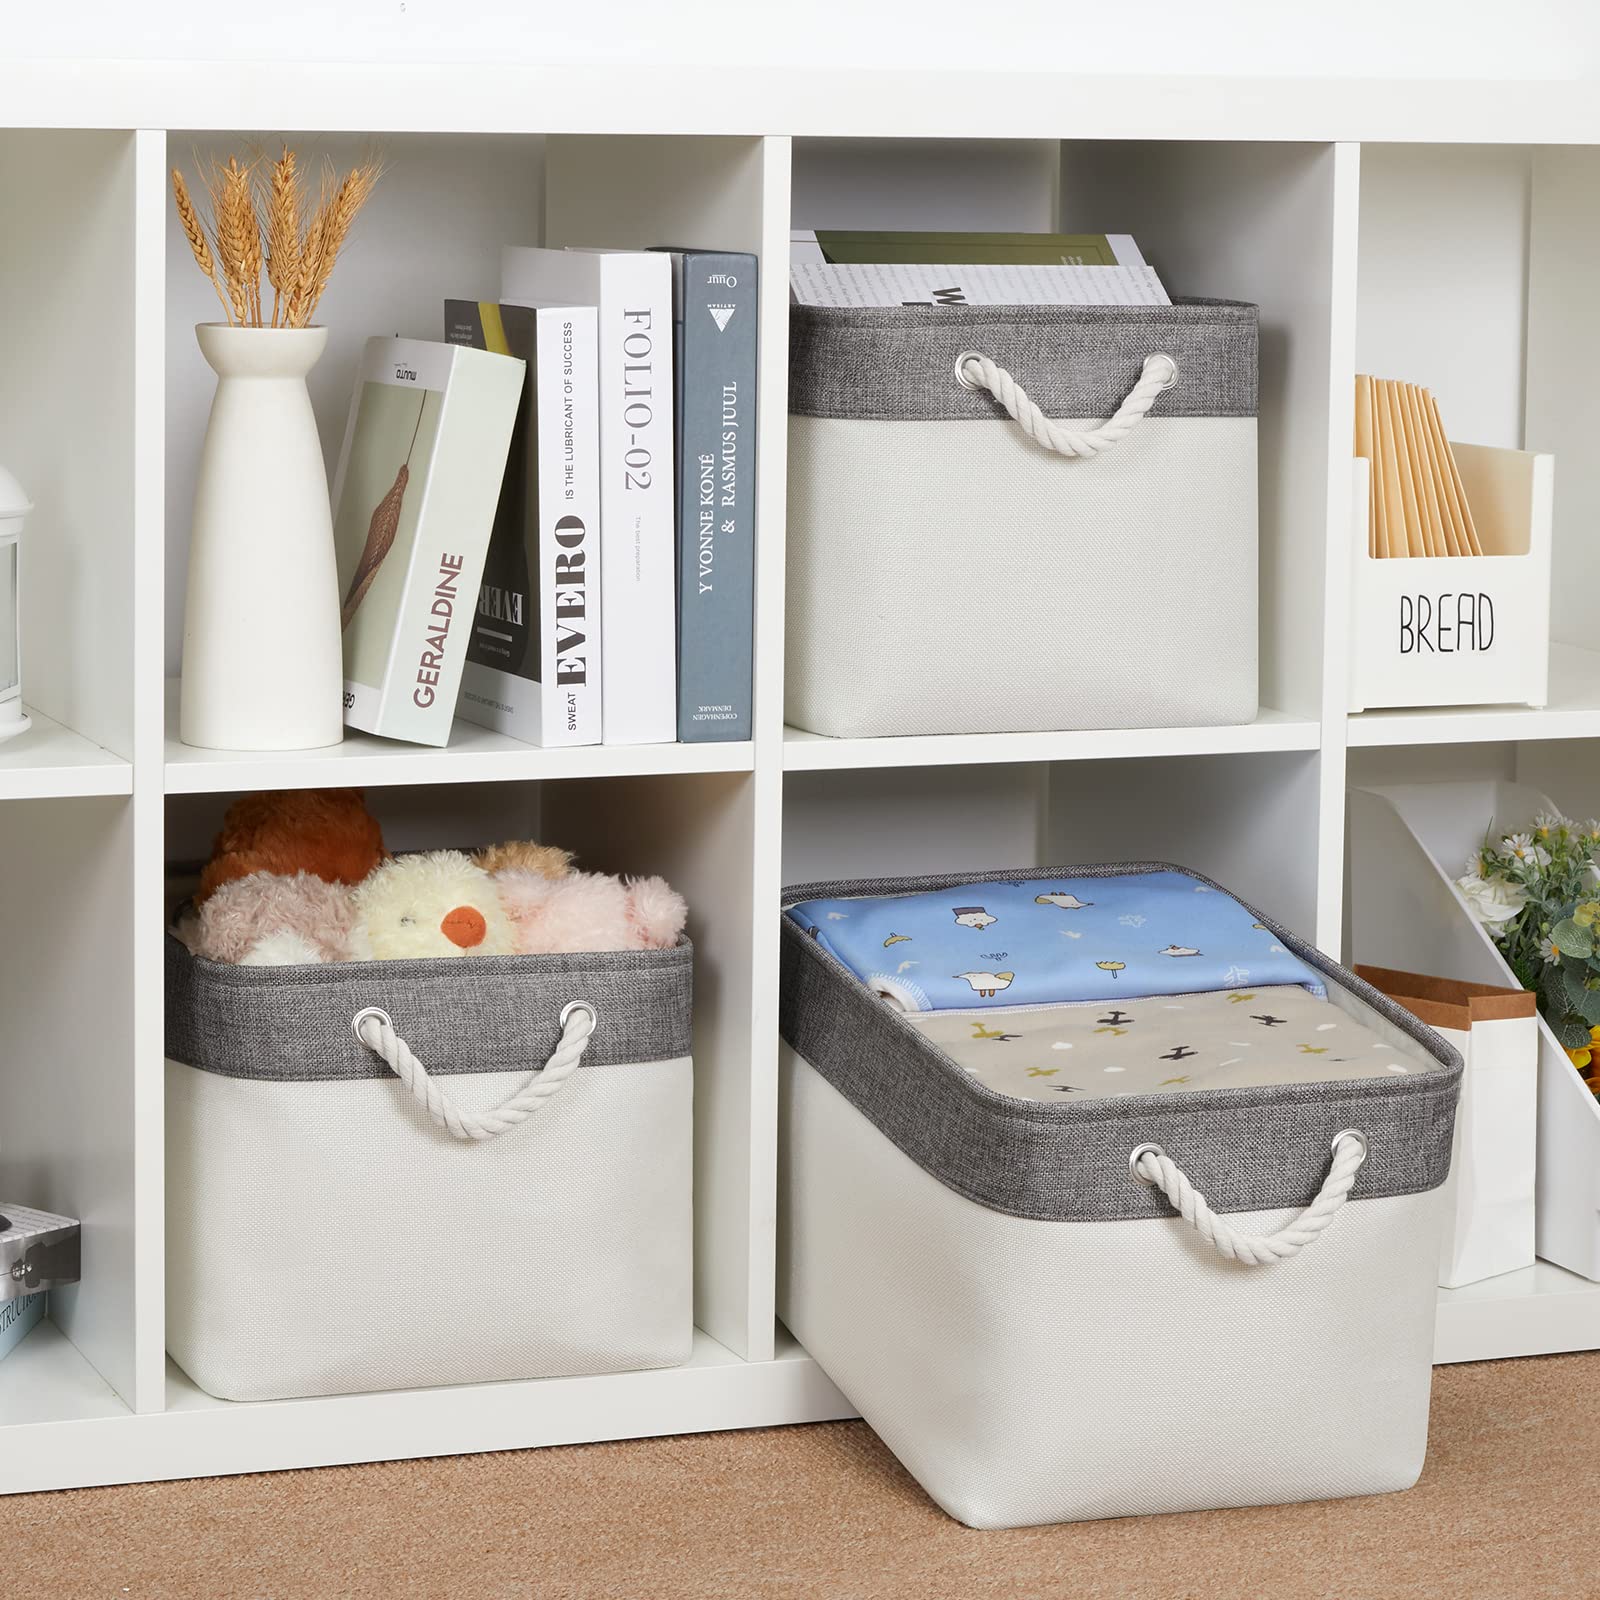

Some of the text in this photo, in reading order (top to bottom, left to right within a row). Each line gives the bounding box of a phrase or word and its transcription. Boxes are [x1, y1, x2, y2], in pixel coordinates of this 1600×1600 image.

[563, 322, 574, 500] IS THE LUBRICANT OF SUCCESS
[624, 308, 652, 490] FOLIO-02
[721, 381, 739, 533] & RASMUS JUUL
[698, 453, 715, 506] KONÉ
[413, 553, 464, 708] GERALDINE
[554, 515, 587, 688] EVERO
[1400, 593, 1494, 653] BREAD
[567, 692, 577, 731] SWEAT
[692, 713, 738, 721] COPENHAGEN
